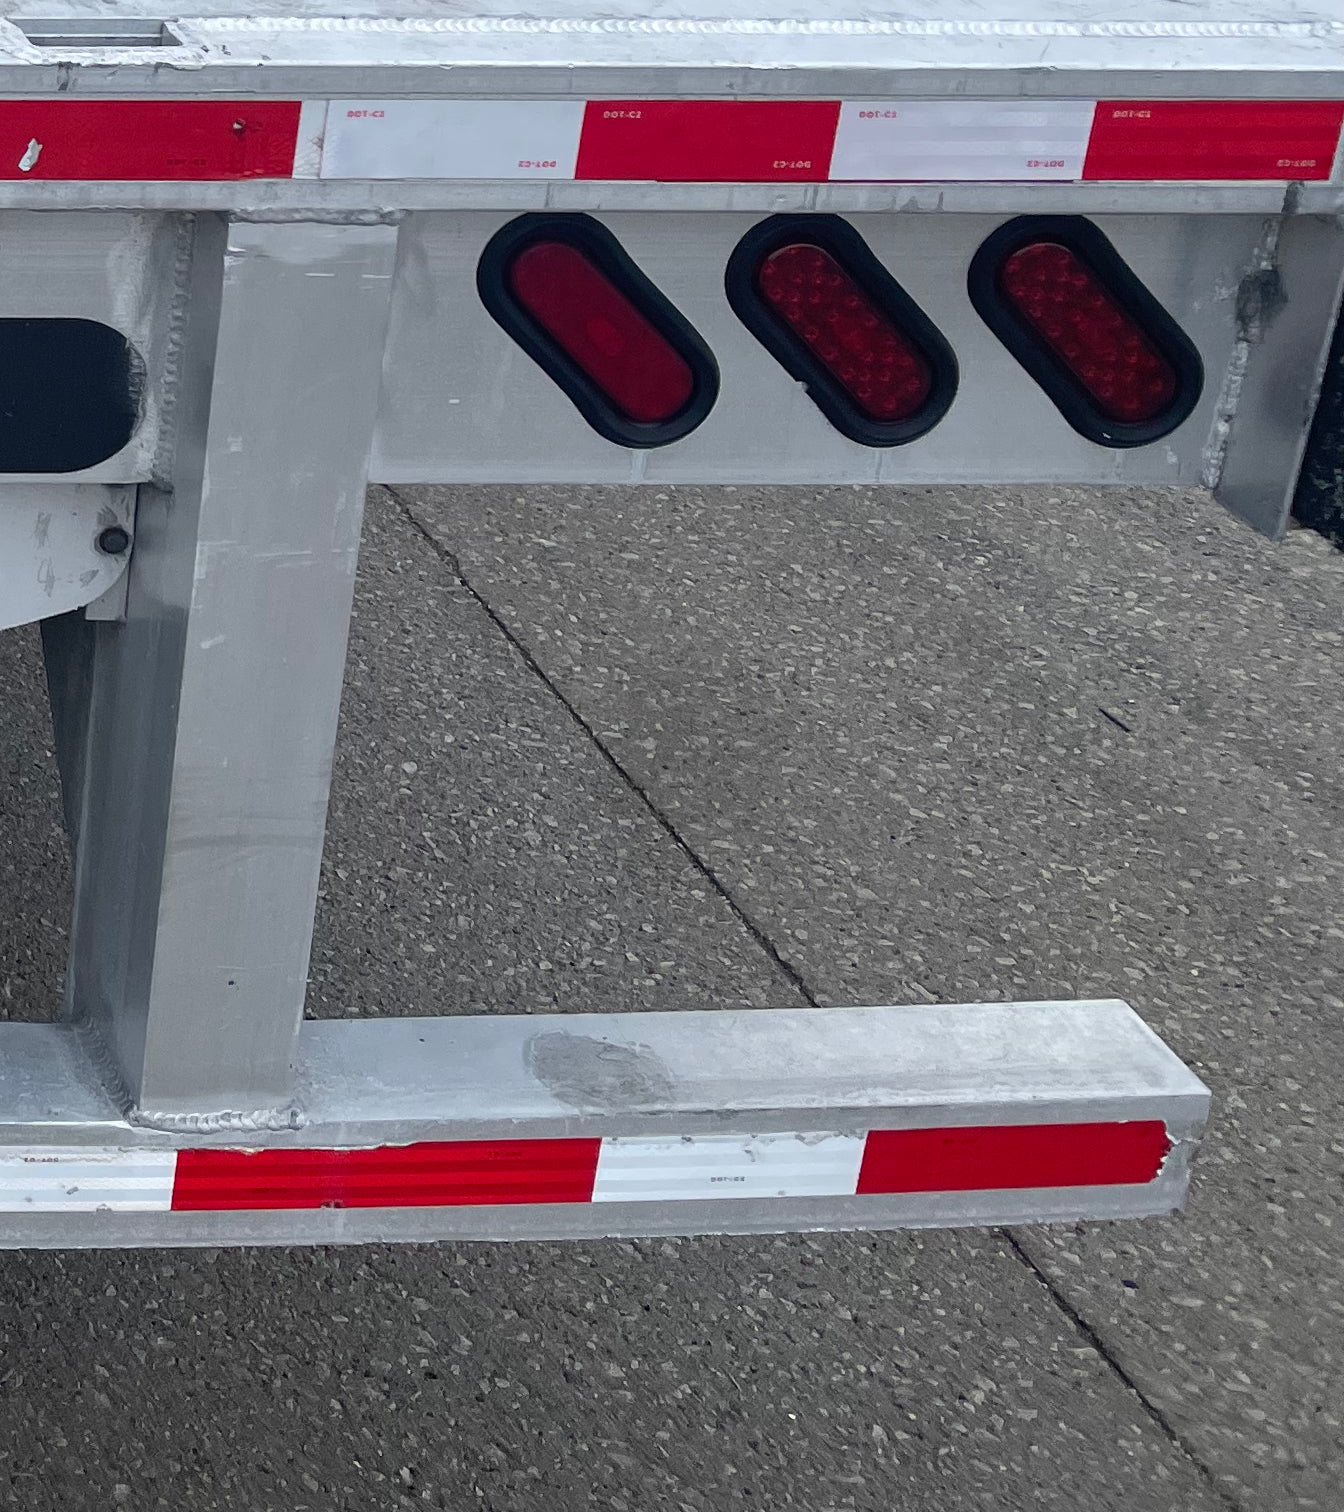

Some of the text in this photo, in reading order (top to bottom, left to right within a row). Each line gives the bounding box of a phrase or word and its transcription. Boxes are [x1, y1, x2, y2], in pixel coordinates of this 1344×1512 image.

[348, 110, 386, 118] DOT-C2
[518, 160, 557, 168] DOT-C2
[773, 160, 811, 168] DOT-C2
